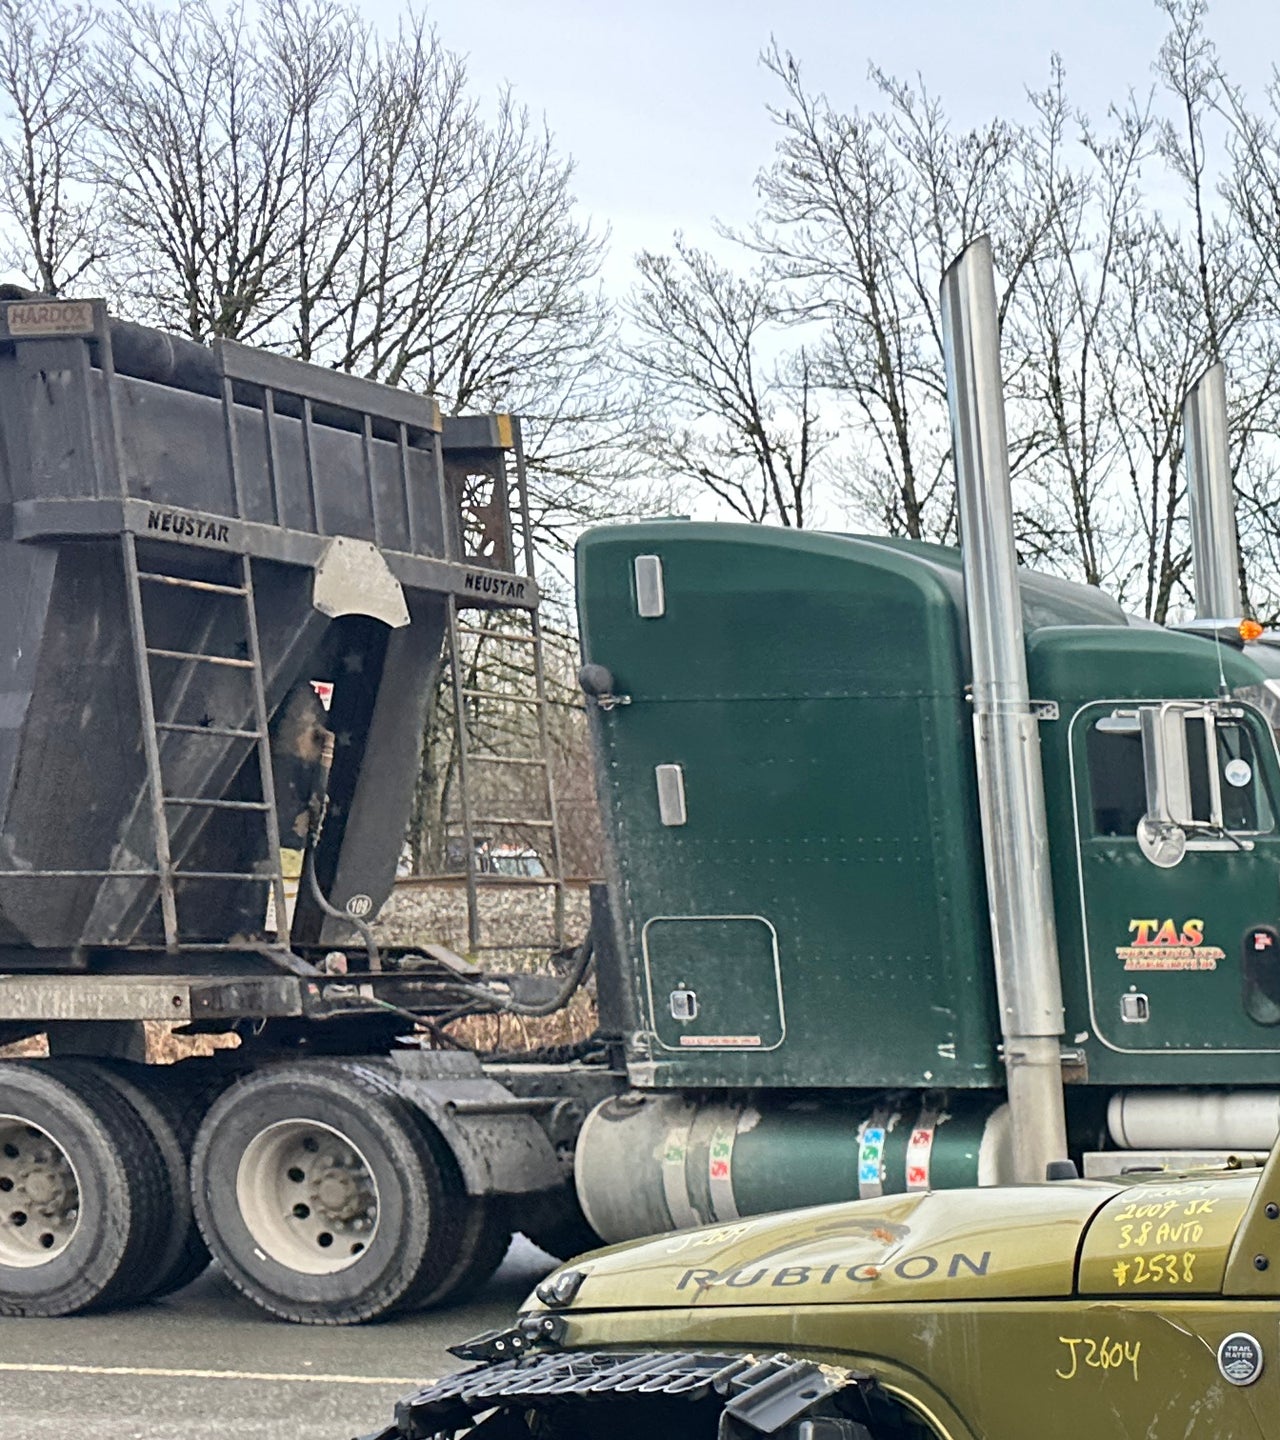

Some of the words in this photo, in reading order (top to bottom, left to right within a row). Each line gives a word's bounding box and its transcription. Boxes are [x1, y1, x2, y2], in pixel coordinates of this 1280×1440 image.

[12, 305, 86, 324] HARDOX
[147, 510, 229, 543] NEUSTAR
[464, 573, 525, 599] NEUSTAR
[1128, 918, 1204, 947] TAS
[1114, 1200, 1180, 1222] 2007
[1184, 1198, 1220, 1216] JK
[1155, 1220, 1204, 1245] AUTO
[676, 1251, 992, 1304] RUBICON
[1112, 1251, 1196, 1287] #2538
[1055, 1336, 1141, 1382] J2604
[1224, 1351, 1254, 1359] RATED
